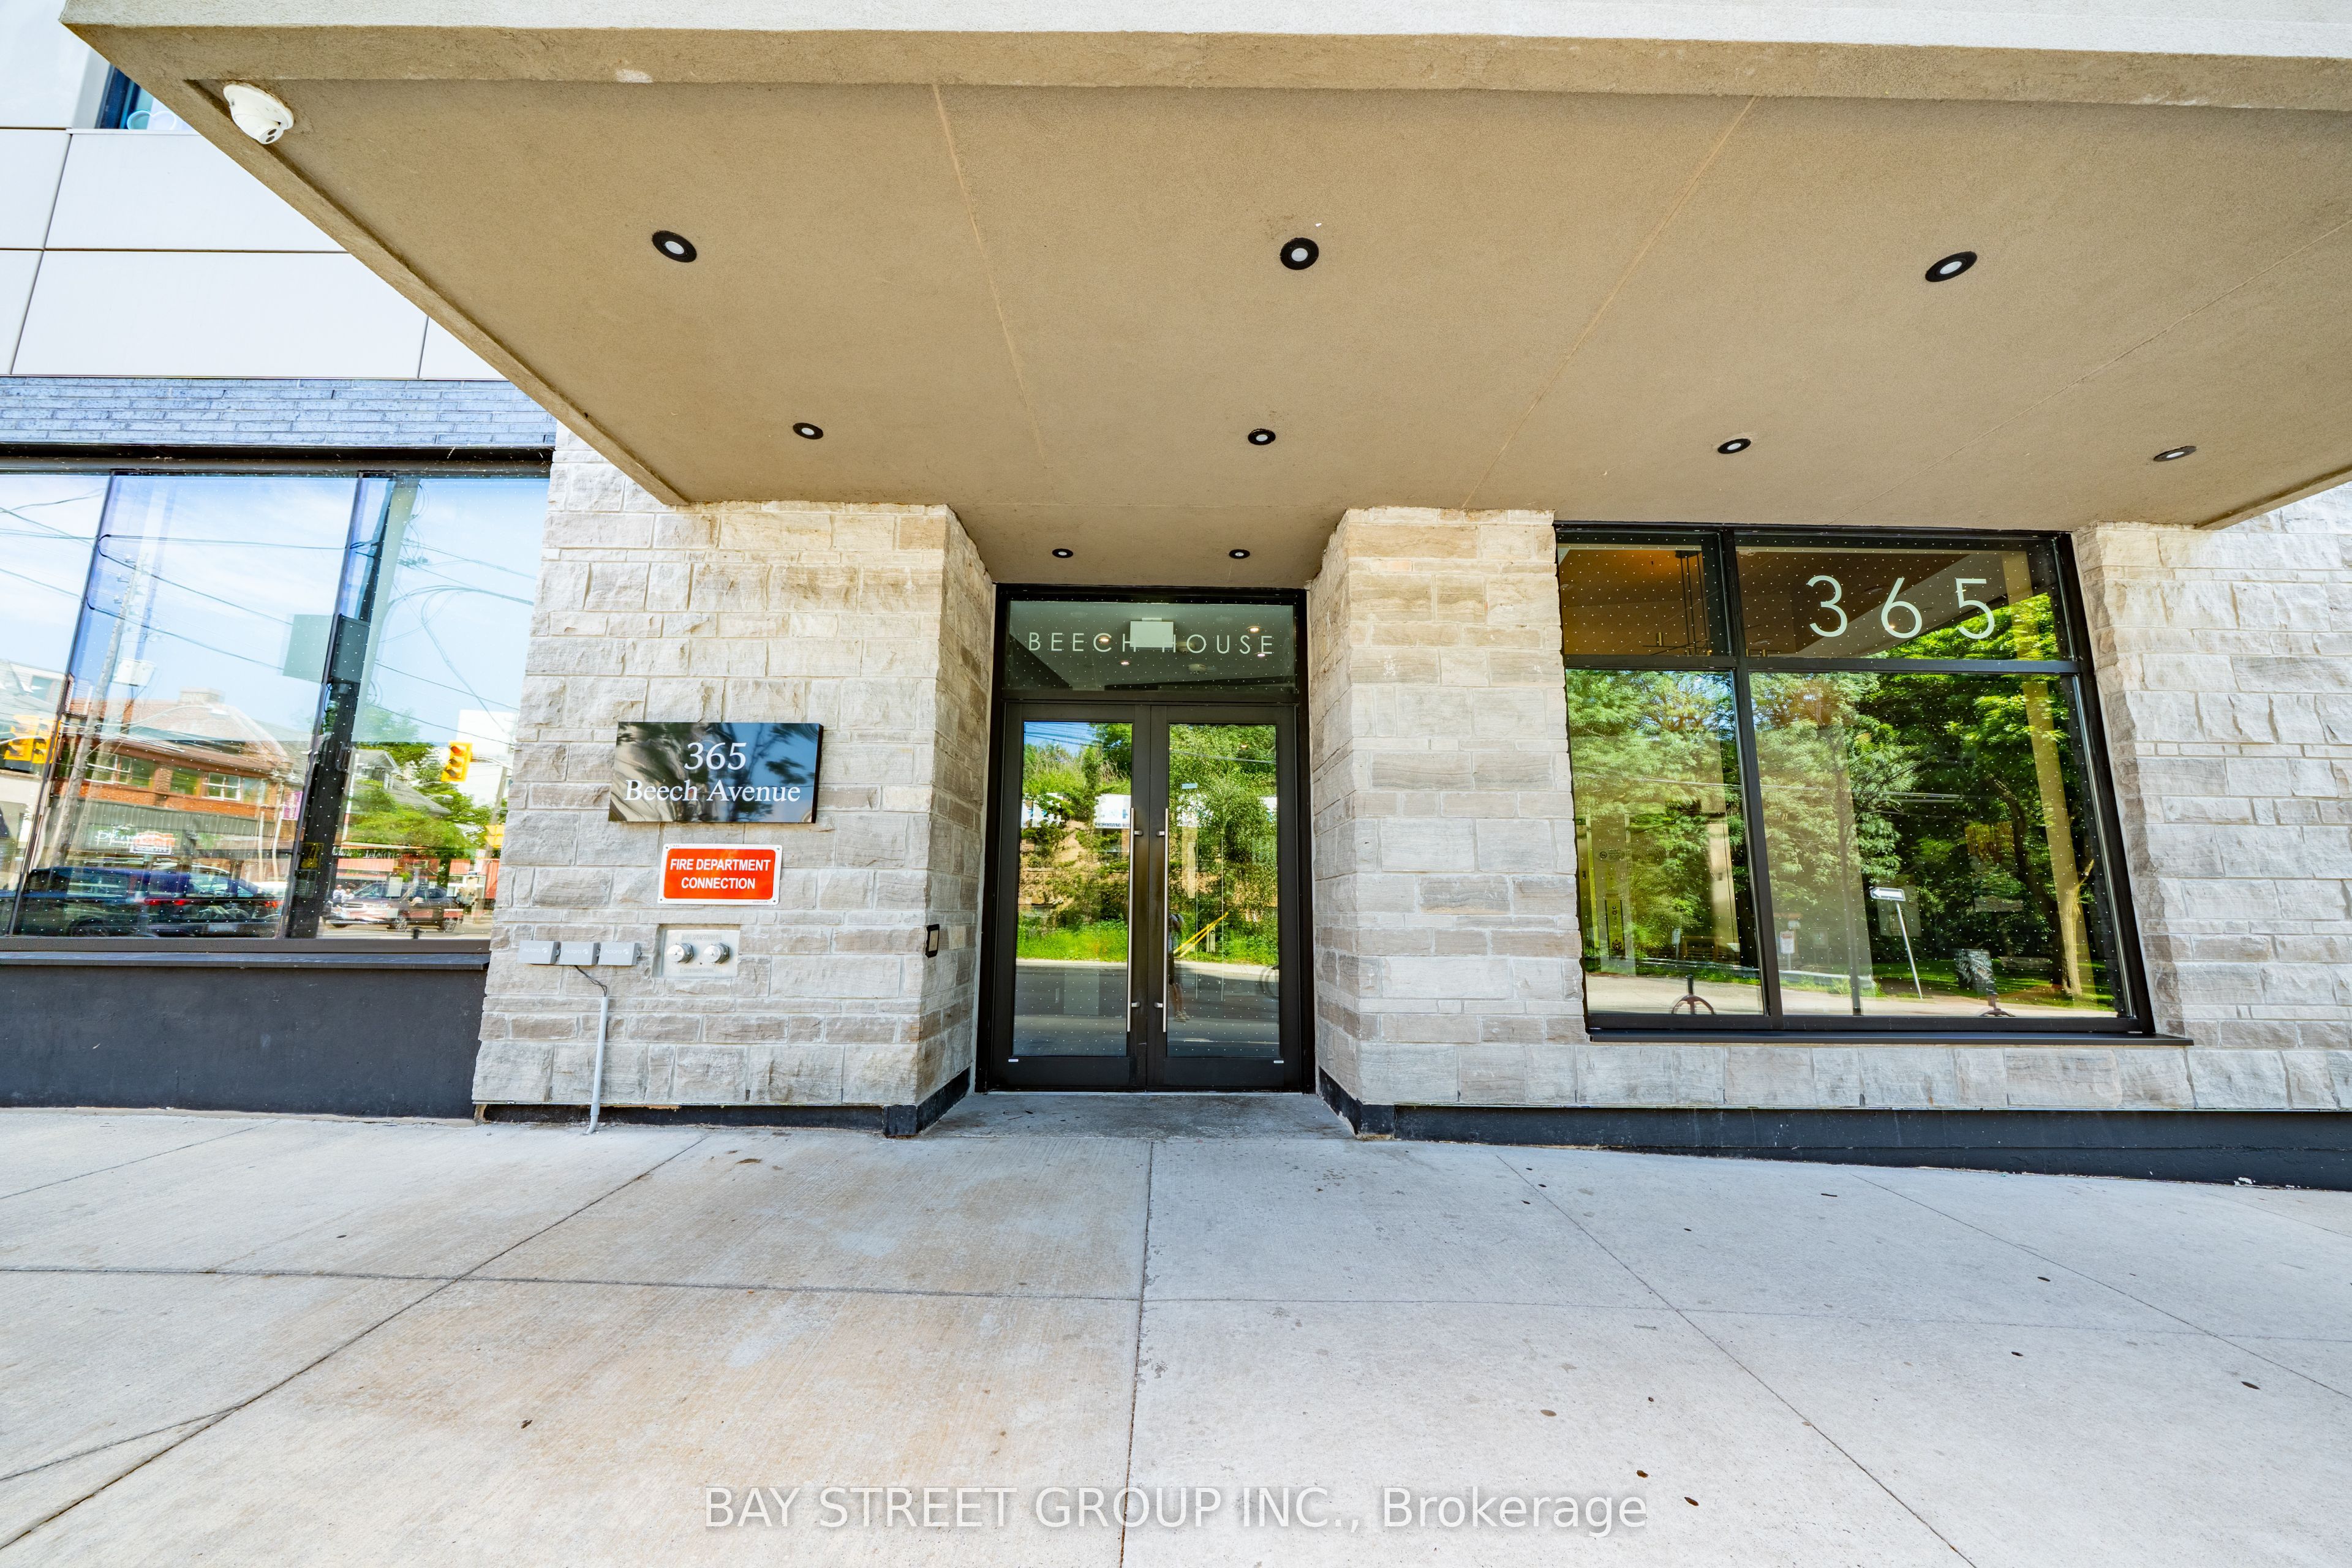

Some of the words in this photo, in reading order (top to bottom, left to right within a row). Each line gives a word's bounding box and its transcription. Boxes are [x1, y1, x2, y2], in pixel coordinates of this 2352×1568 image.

[1806, 575, 1995, 639] 365
[1028, 632, 1136, 652] BEECH
[1162, 634, 1272, 654] HOUSE
[684, 742, 747, 771] 365
[624, 779, 699, 802] Beech
[706, 779, 801, 802] Avenue
[670, 858, 694, 870] FIRE
[696, 859, 771, 871] DEPARTMENT
[681, 877, 755, 889] CONNECTION
